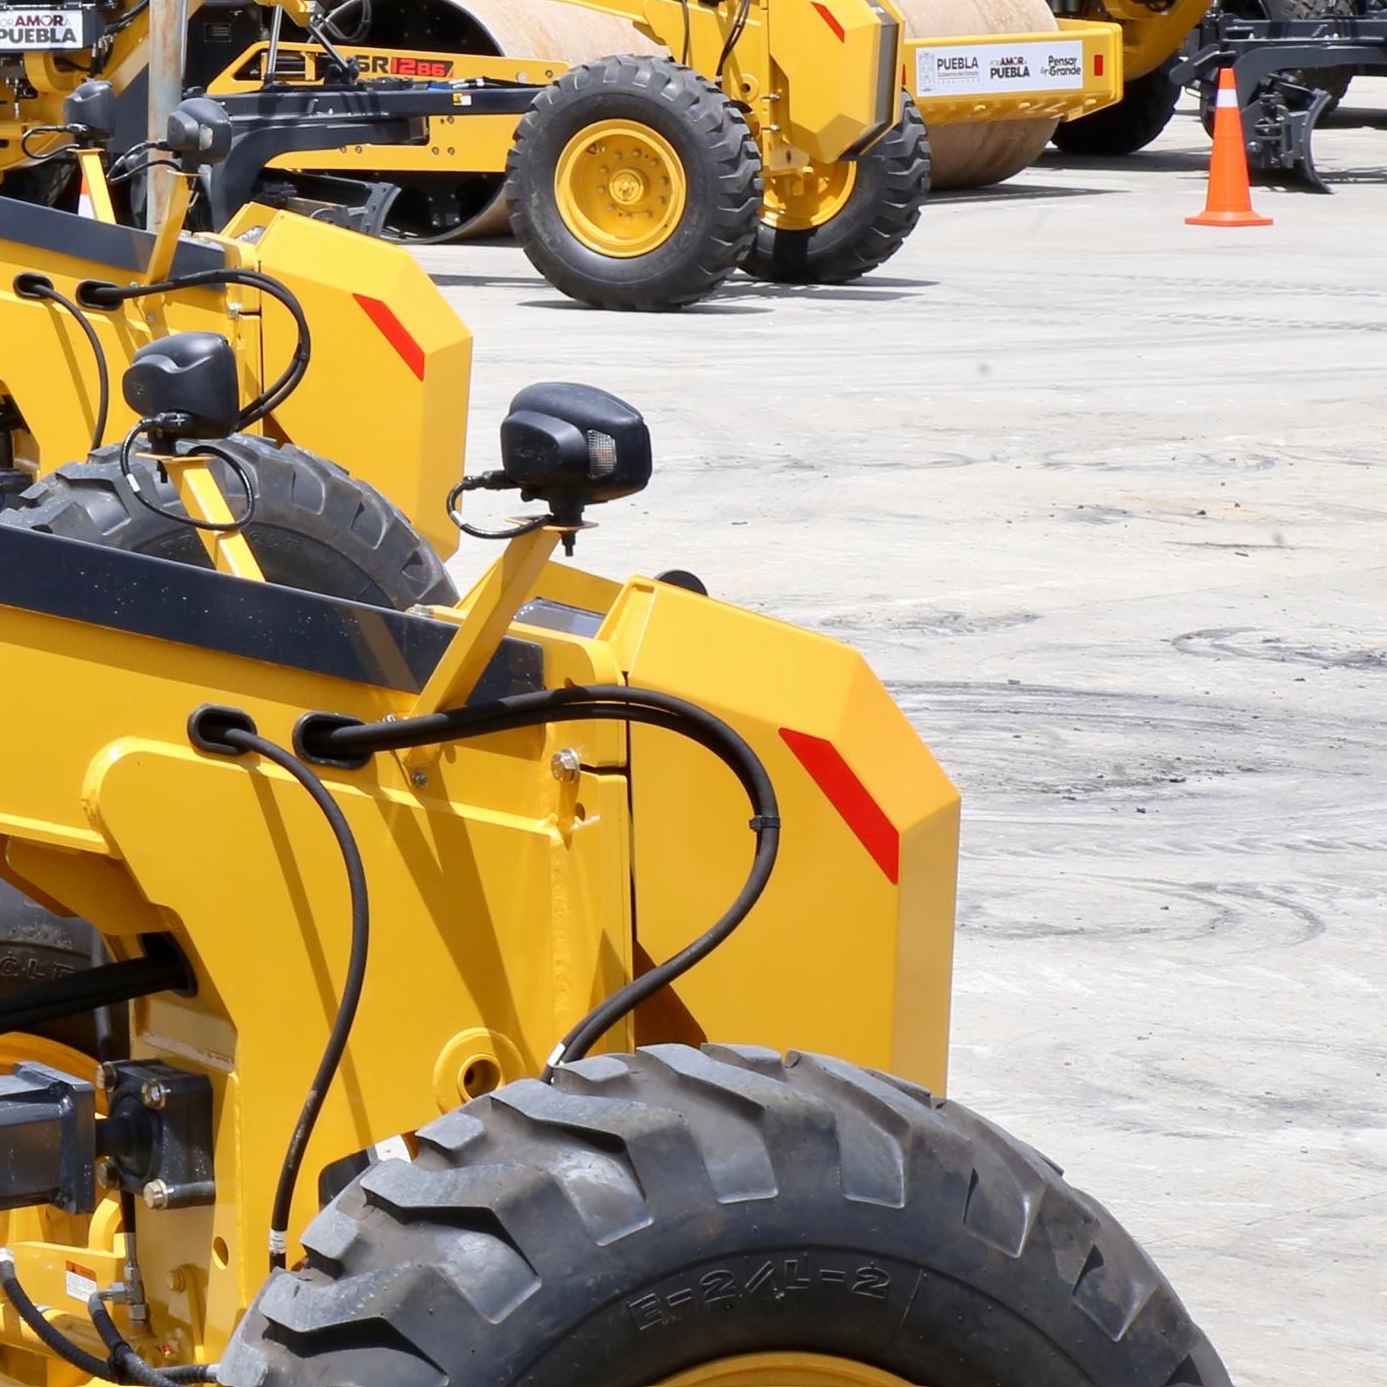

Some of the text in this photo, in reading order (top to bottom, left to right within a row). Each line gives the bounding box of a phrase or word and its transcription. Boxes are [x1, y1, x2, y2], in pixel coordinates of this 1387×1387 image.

[15, 15, 64, 27] AMOR
[937, 56, 979, 70] PUEBLA
[1048, 55, 1077, 66] Pensar
[990, 66, 1030, 79] PUEBLA
[1049, 66, 1081, 77] Grande
